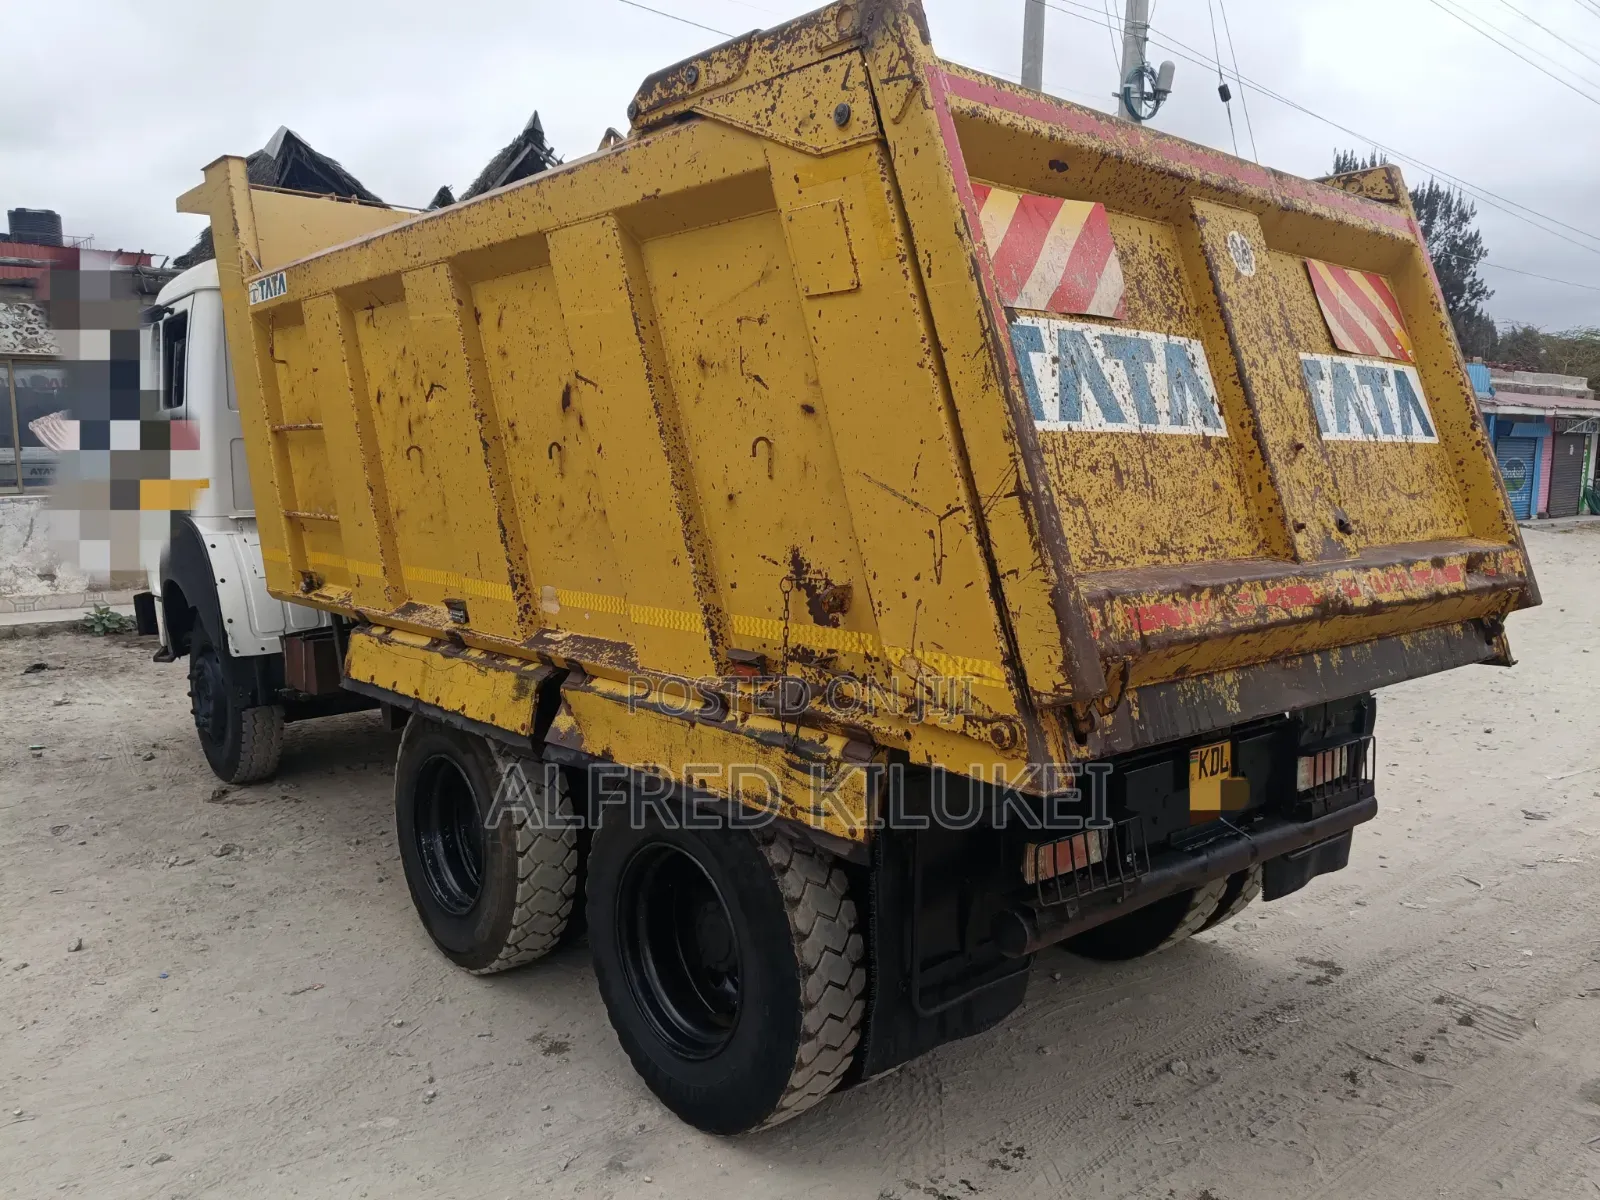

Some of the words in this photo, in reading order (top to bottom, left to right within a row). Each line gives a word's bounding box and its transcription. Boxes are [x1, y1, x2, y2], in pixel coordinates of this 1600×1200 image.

[257, 272, 287, 300] TATA
[1011, 325, 1222, 430] TATA
[1302, 359, 1436, 437] TATA
[1198, 744, 1229, 780] KDL
